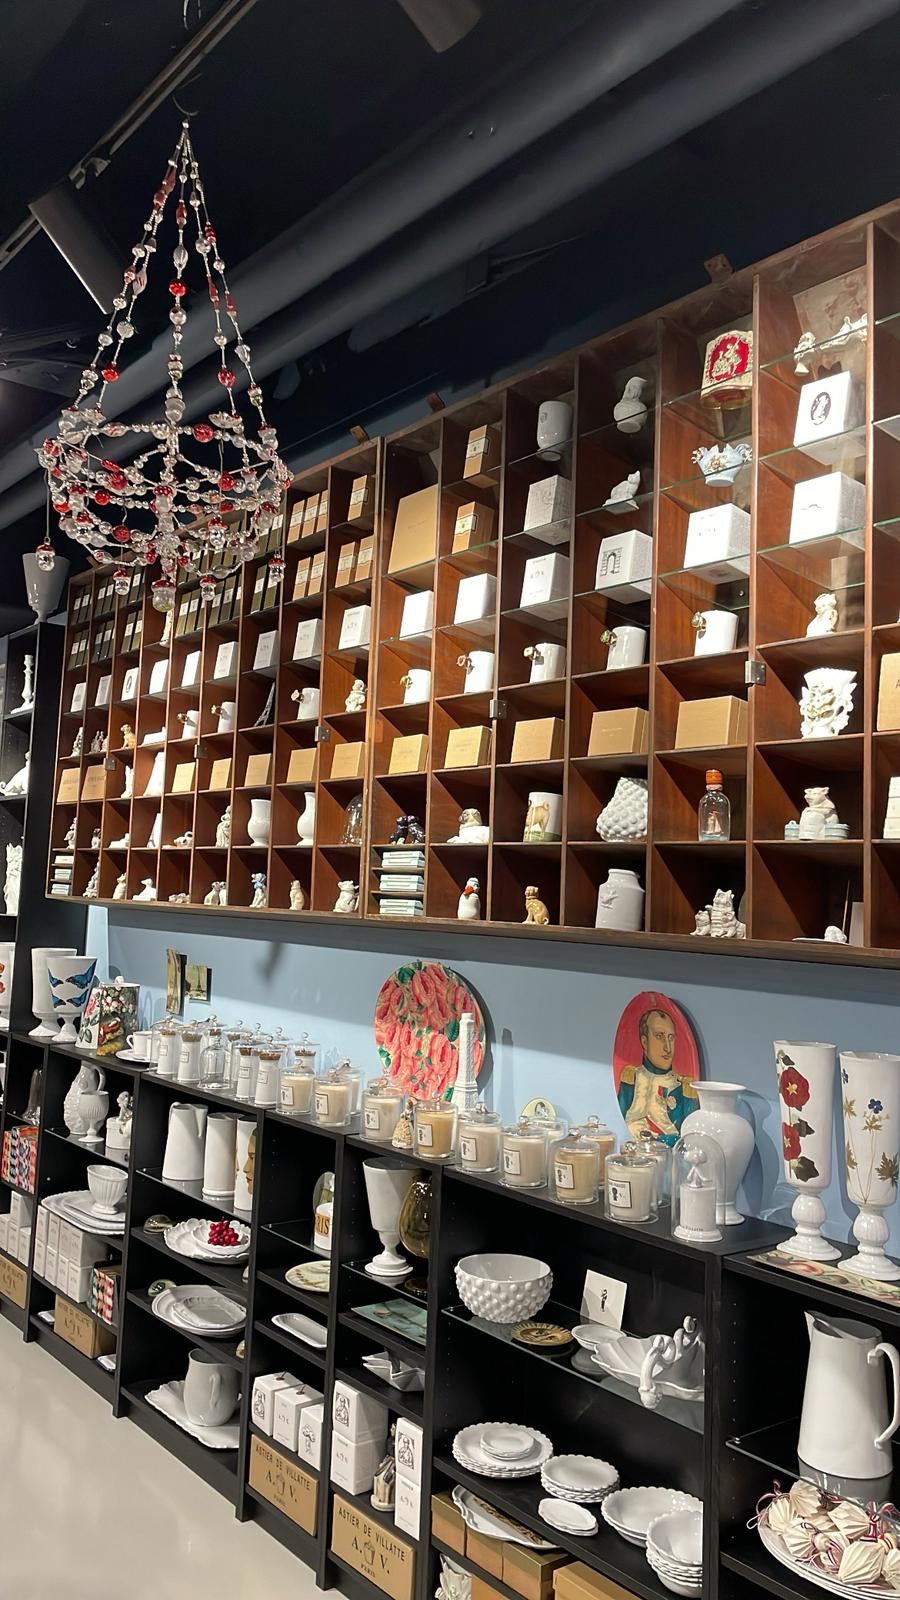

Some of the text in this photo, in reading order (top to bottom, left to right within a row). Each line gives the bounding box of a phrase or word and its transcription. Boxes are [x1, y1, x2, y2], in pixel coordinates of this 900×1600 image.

[255, 1444, 310, 1490] ASTIER DE VILLATTE
[338, 1507, 405, 1562] ASTIER DE VILLATTE
